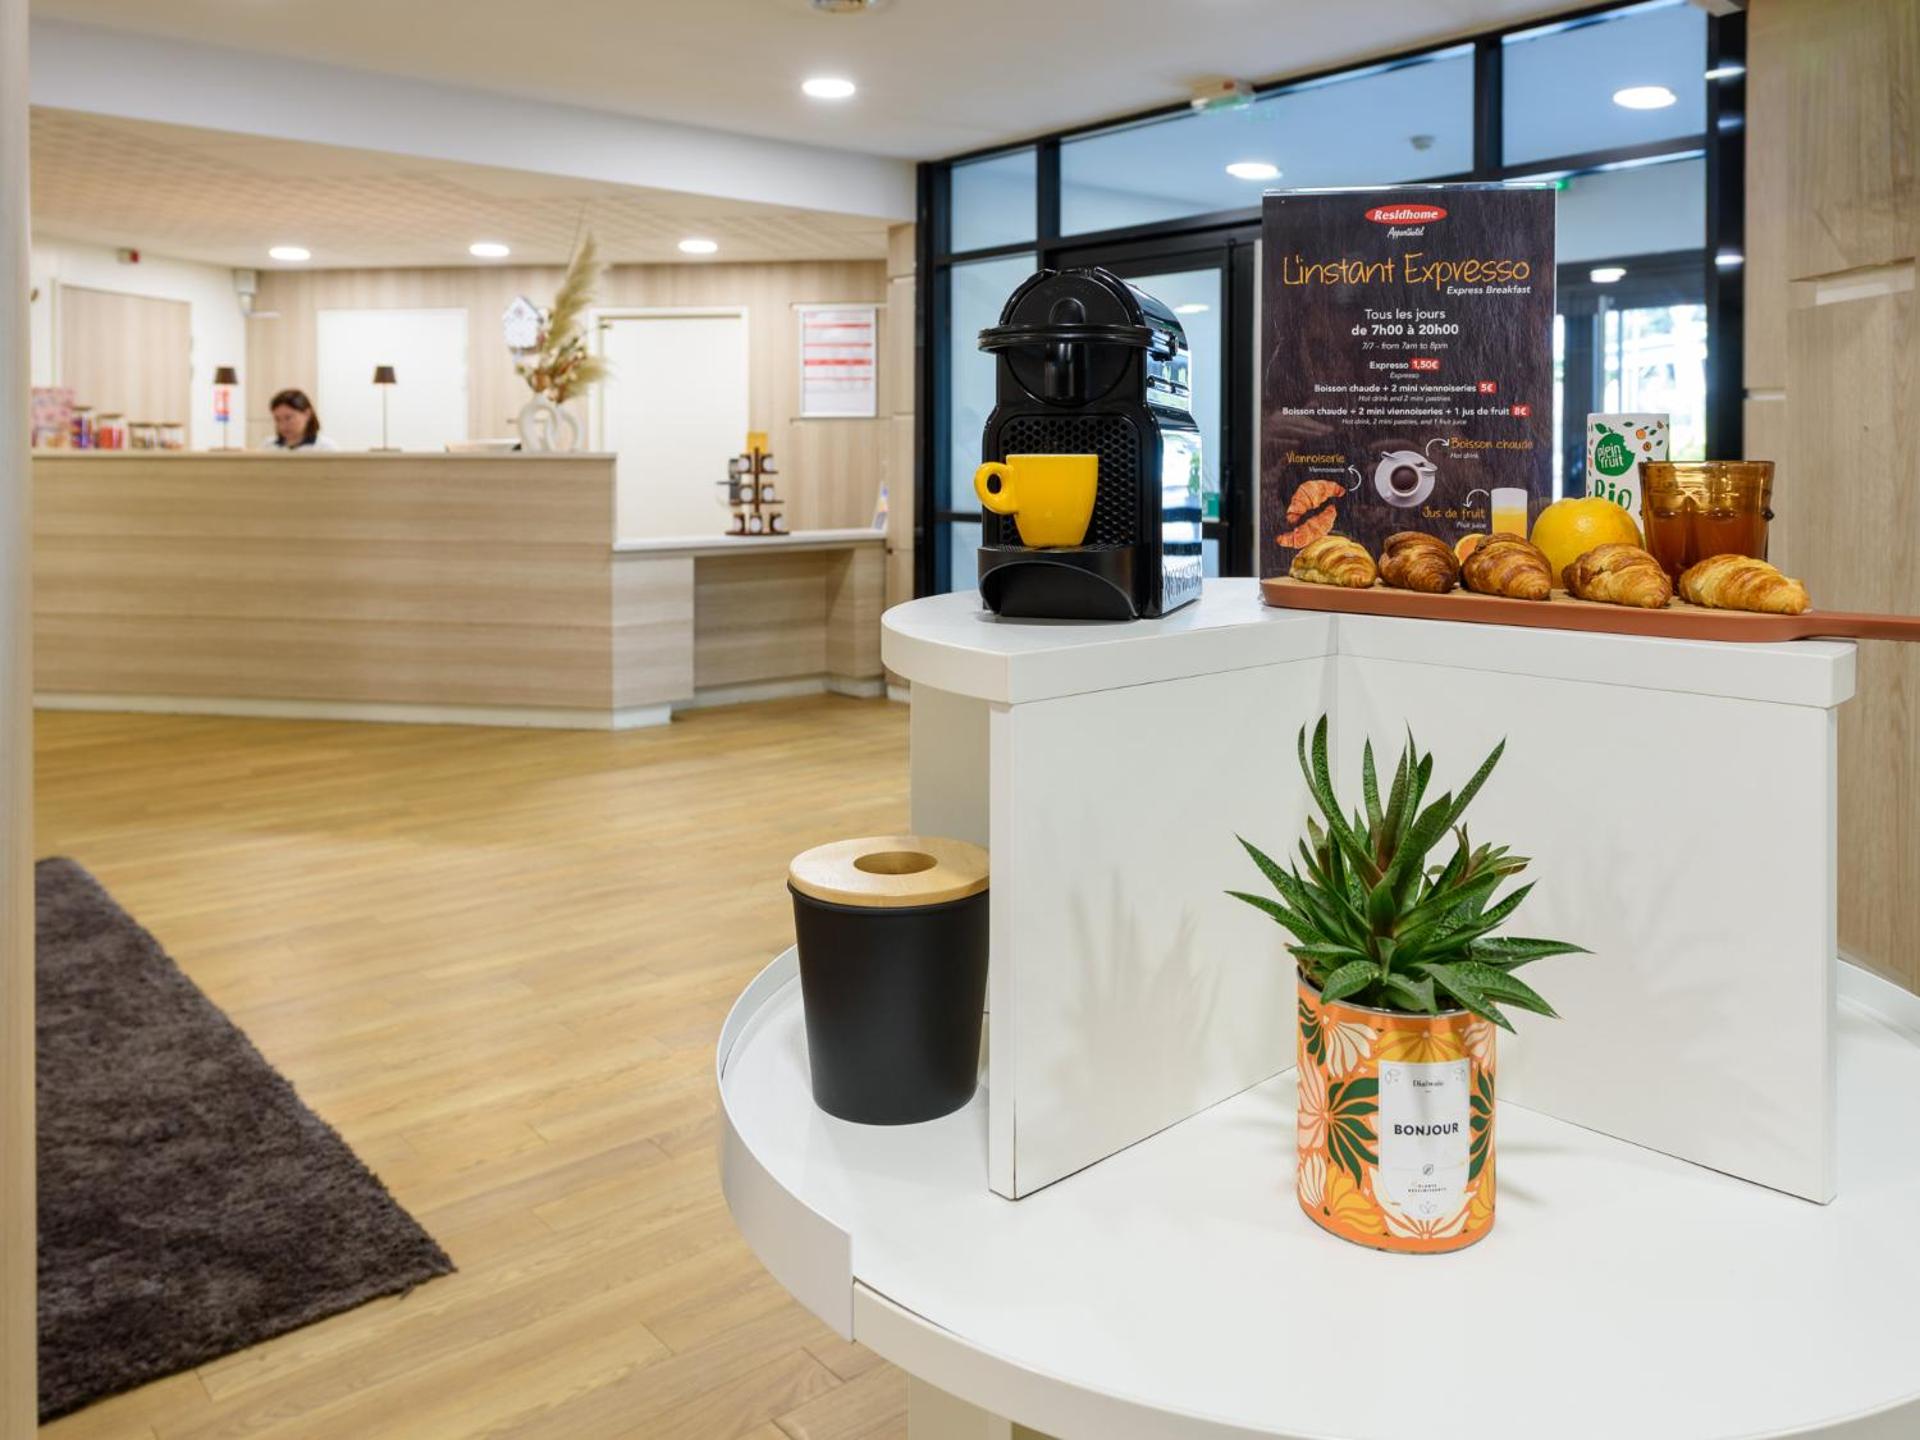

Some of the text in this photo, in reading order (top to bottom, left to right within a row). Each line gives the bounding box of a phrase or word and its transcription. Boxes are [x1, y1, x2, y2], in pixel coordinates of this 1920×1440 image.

[1374, 210, 1439, 221] Residhome
[1283, 252, 1531, 292] L'instant Expresso
[1446, 285, 1532, 296] Express Breakfast
[1364, 308, 1446, 322] Tous les jours
[1351, 324, 1459, 336] de 7h00 à 20h00
[1361, 342, 1375, 350] 7/7
[1381, 341, 1400, 350] from
[1401, 342, 1418, 350] 7am
[1420, 342, 1428, 350] to
[1369, 361, 1439, 371] Expresso 1,50€
[1314, 384, 1347, 393] Boisson
[1349, 384, 1381, 393] chaude
[1391, 384, 1398, 393] 2
[1400, 384, 1418, 393] mini
[1420, 384, 1477, 393] viennoiseries
[1481, 384, 1494, 393] 5€
[1282, 407, 1315, 416] Boisson
[1317, 407, 1348, 416] chaude
[1358, 407, 1364, 416] 2
[1366, 407, 1385, 416] mini
[1387, 407, 1443, 416] viennoiseries
[1461, 407, 1475, 418] jus
[1476, 407, 1489, 416] de
[1490, 407, 1510, 416] fruit
[1450, 436, 1492, 449] Boisson
[1597, 443, 1621, 462] plein
[1600, 456, 1624, 469] fruit
[1594, 479, 1632, 511] Bio
[1422, 506, 1486, 520] Jus de fruit
[1394, 1122, 1459, 1136] BONJOUR
